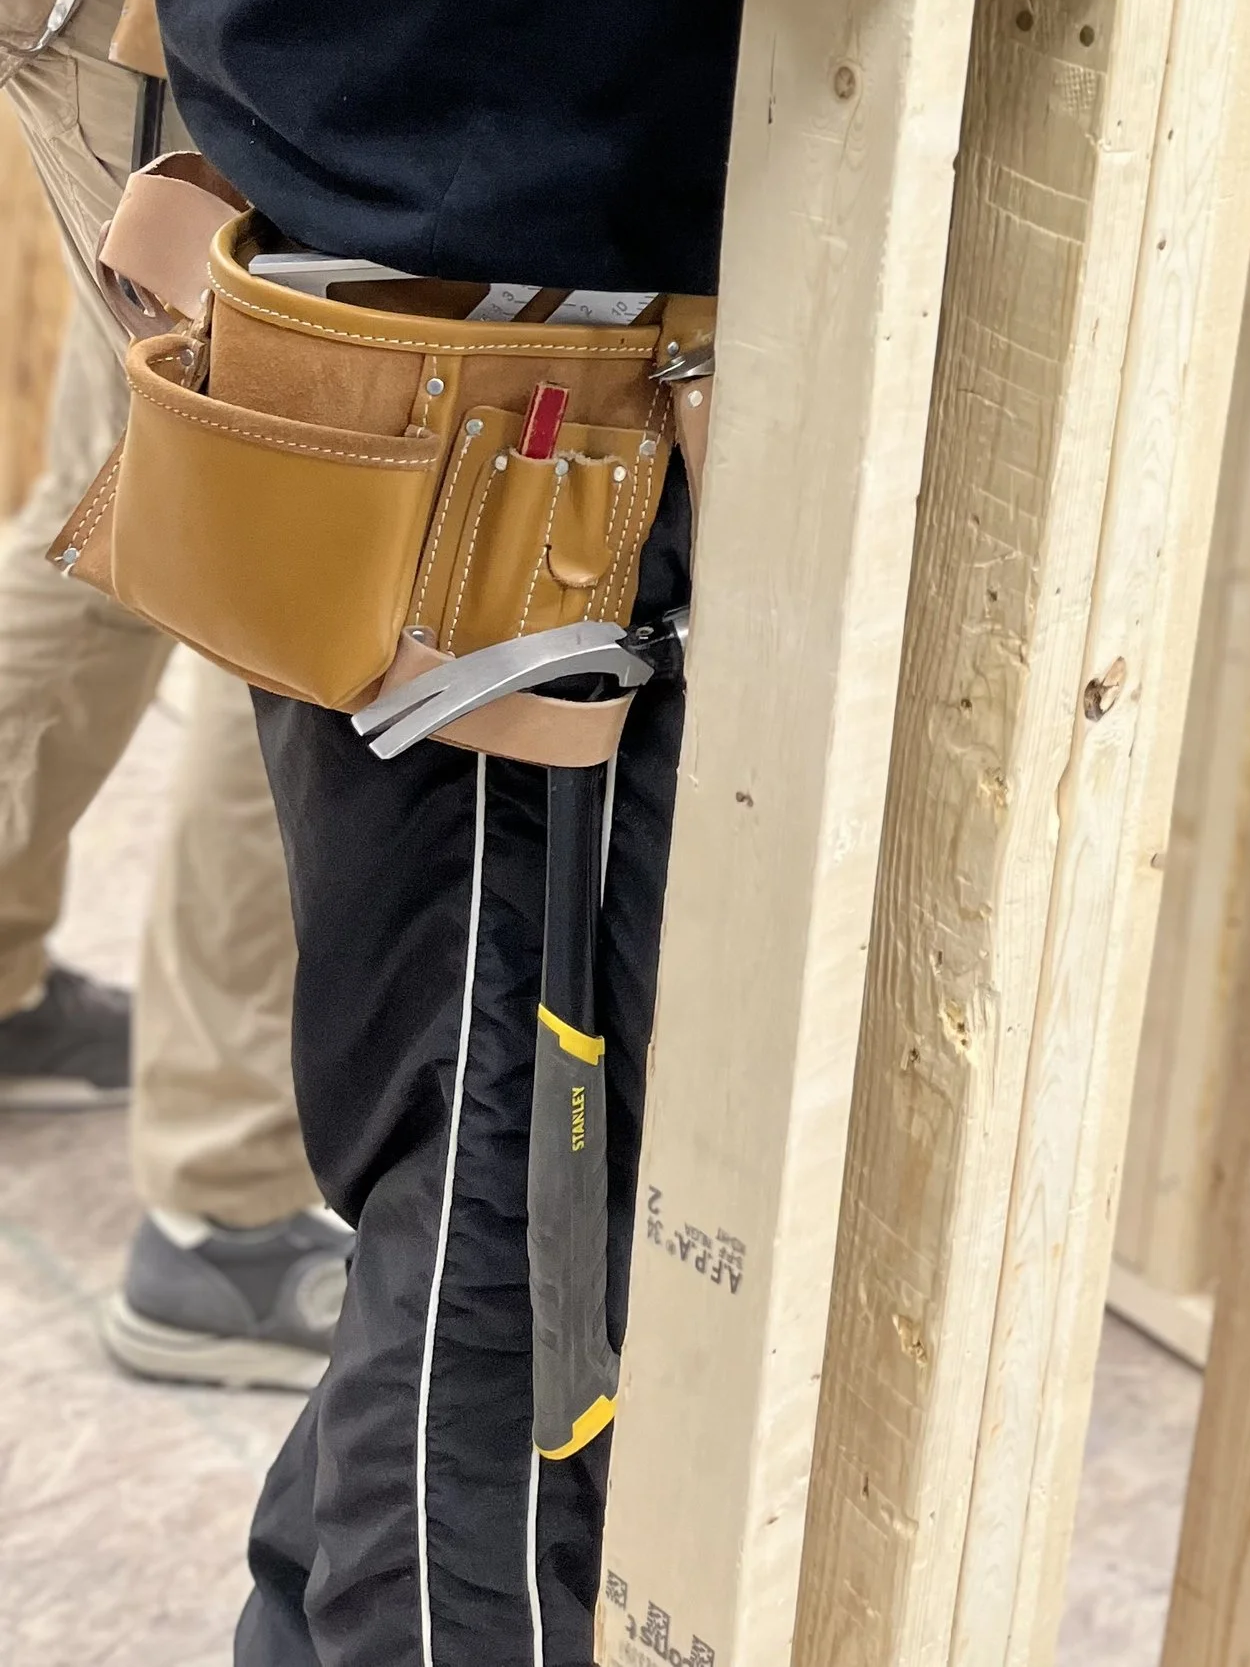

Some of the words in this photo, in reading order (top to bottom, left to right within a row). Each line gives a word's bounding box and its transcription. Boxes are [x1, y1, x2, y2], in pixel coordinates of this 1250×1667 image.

[611, 301, 628, 317] 10
[571, 1086, 585, 1152] STANLEY
[648, 1184, 662, 1215] 2
